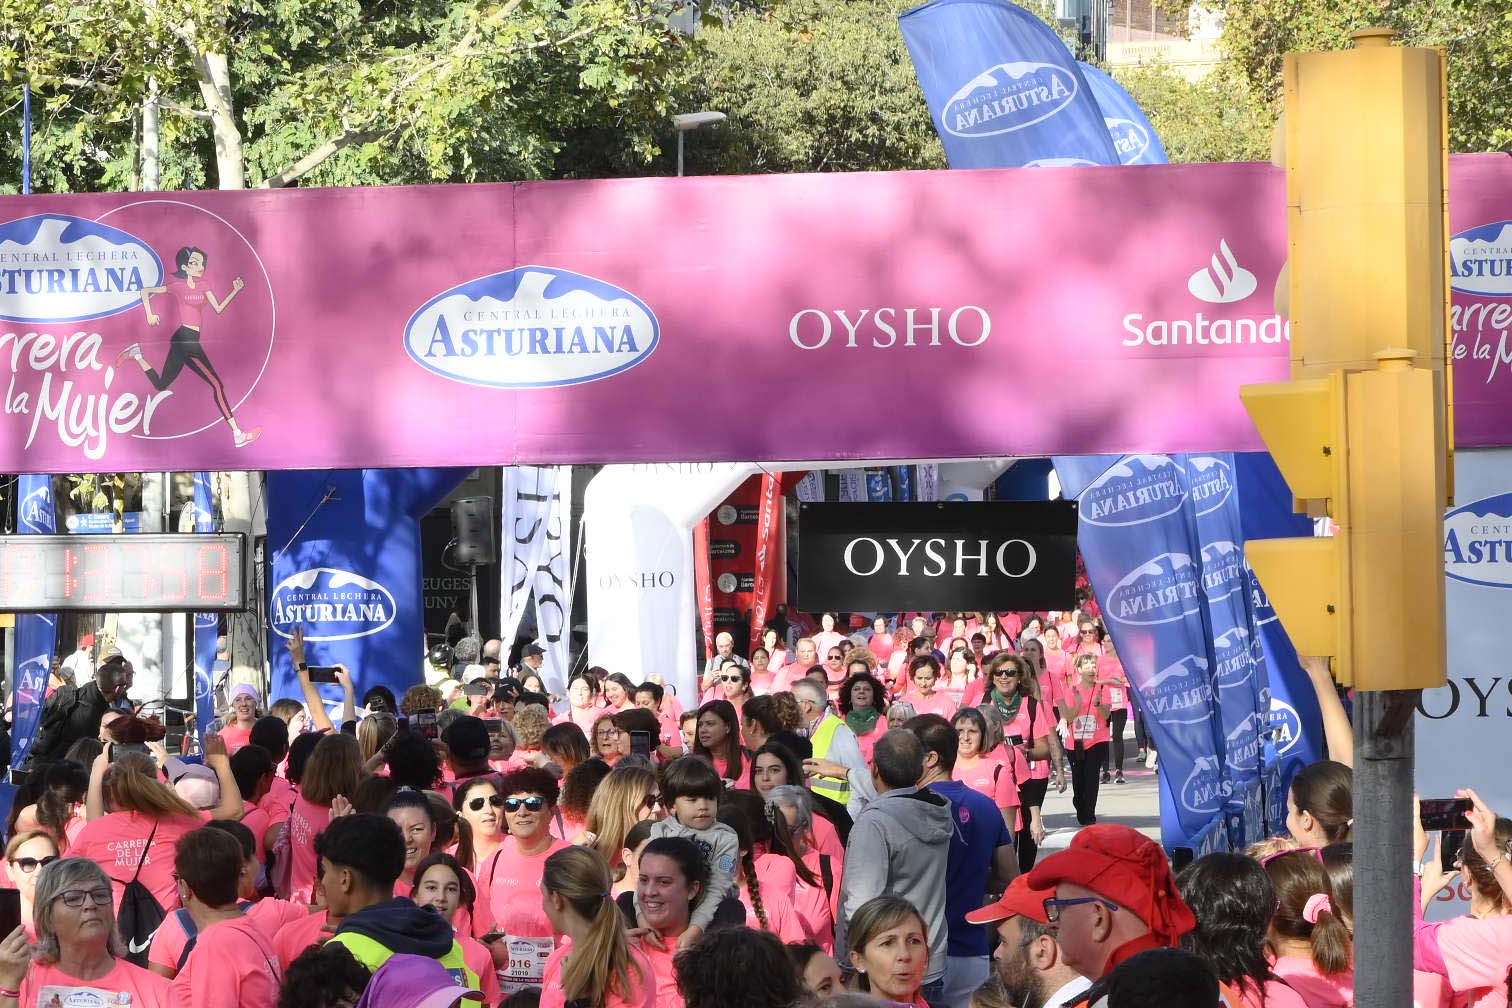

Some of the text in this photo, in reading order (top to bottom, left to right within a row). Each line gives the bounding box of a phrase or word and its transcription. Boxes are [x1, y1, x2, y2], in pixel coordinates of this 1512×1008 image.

[66, 250, 138, 262] LECHERA
[425, 313, 640, 358] ASTURIANA
[788, 305, 992, 350] OYSHO
[1473, 333, 1490, 359] la
[5, 374, 29, 414] la
[25, 367, 174, 460] Mujer
[843, 536, 1037, 579] OYSHO
[600, 571, 675, 589] OYSHO
[274, 598, 386, 624] ASTURIANA
